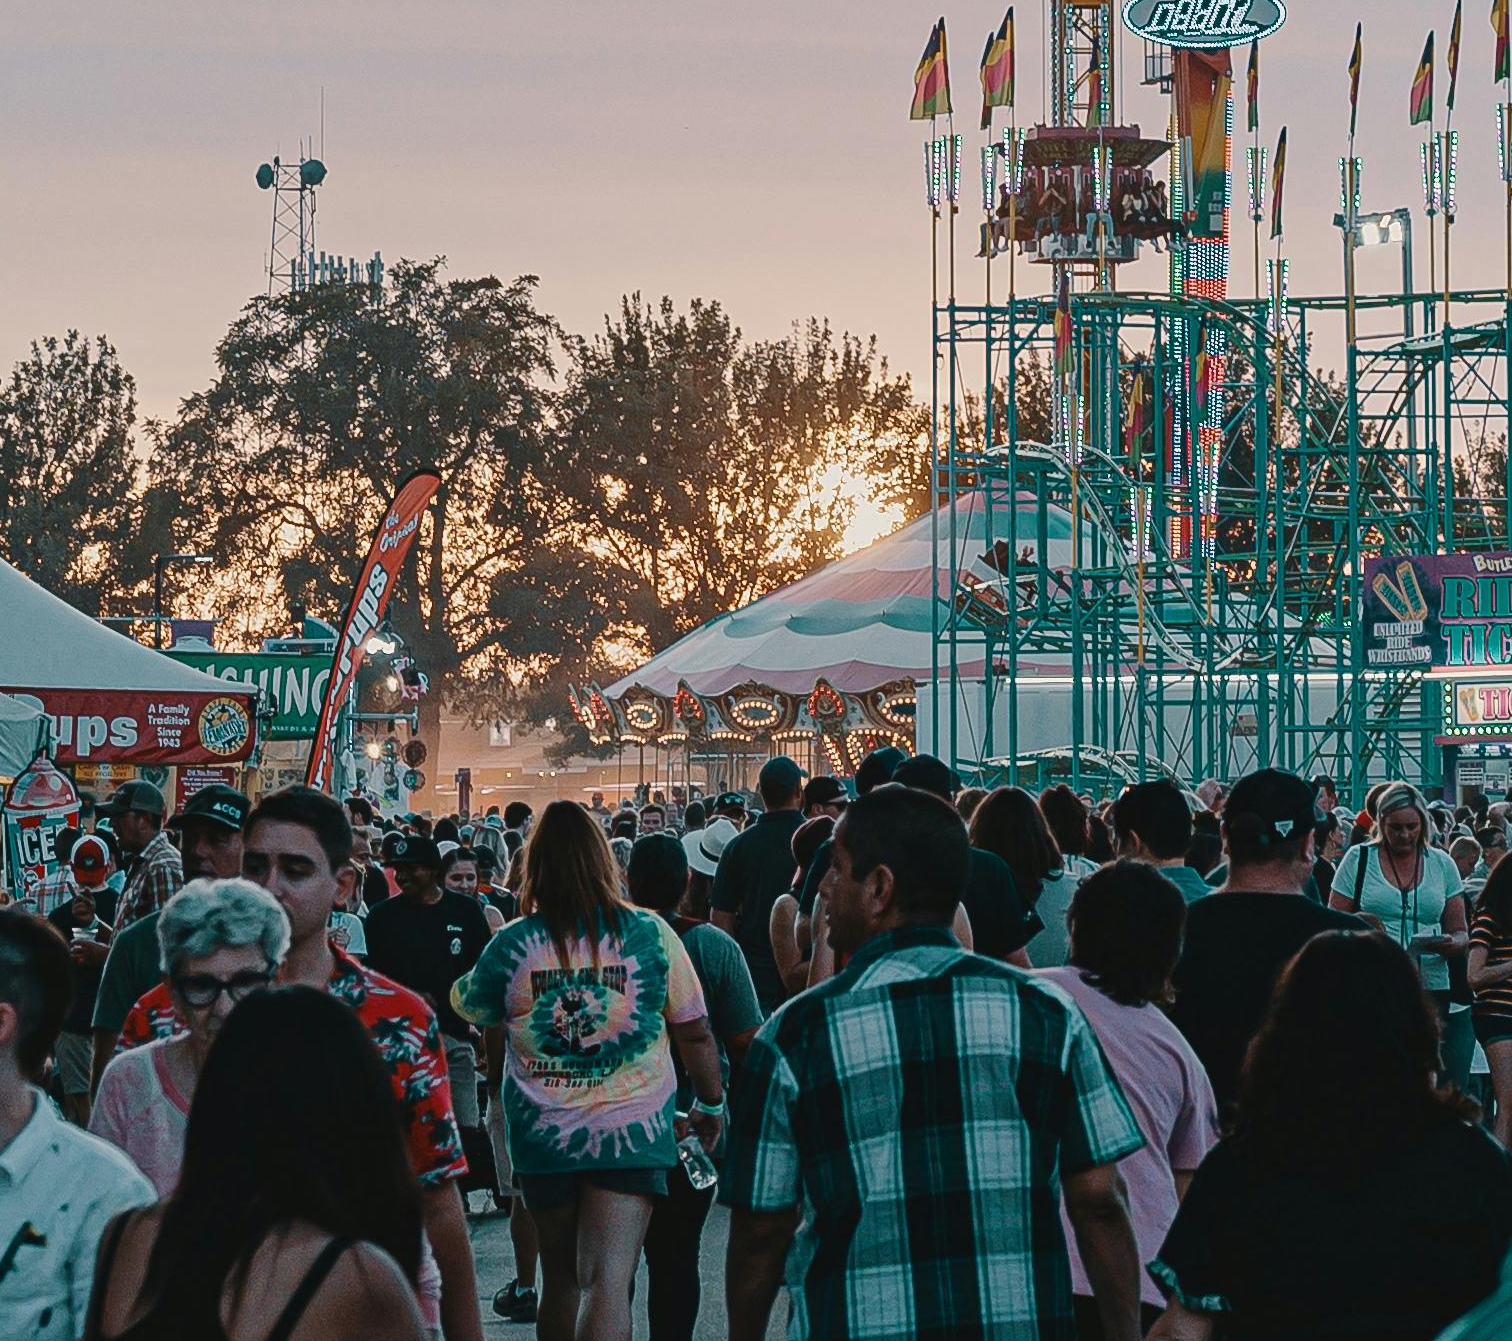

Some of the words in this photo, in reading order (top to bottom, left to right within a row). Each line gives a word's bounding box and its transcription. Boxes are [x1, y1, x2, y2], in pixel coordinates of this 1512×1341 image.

[1386, 636, 1413, 649] RIDE
[1367, 645, 1432, 664] WRISTBANDS
[148, 704, 156, 714] A
[158, 704, 190, 716] Family
[148, 715, 191, 726] Tradition
[157, 726, 182, 738] Since
[157, 738, 181, 749] 1943
[15, 823, 67, 865] ICE
